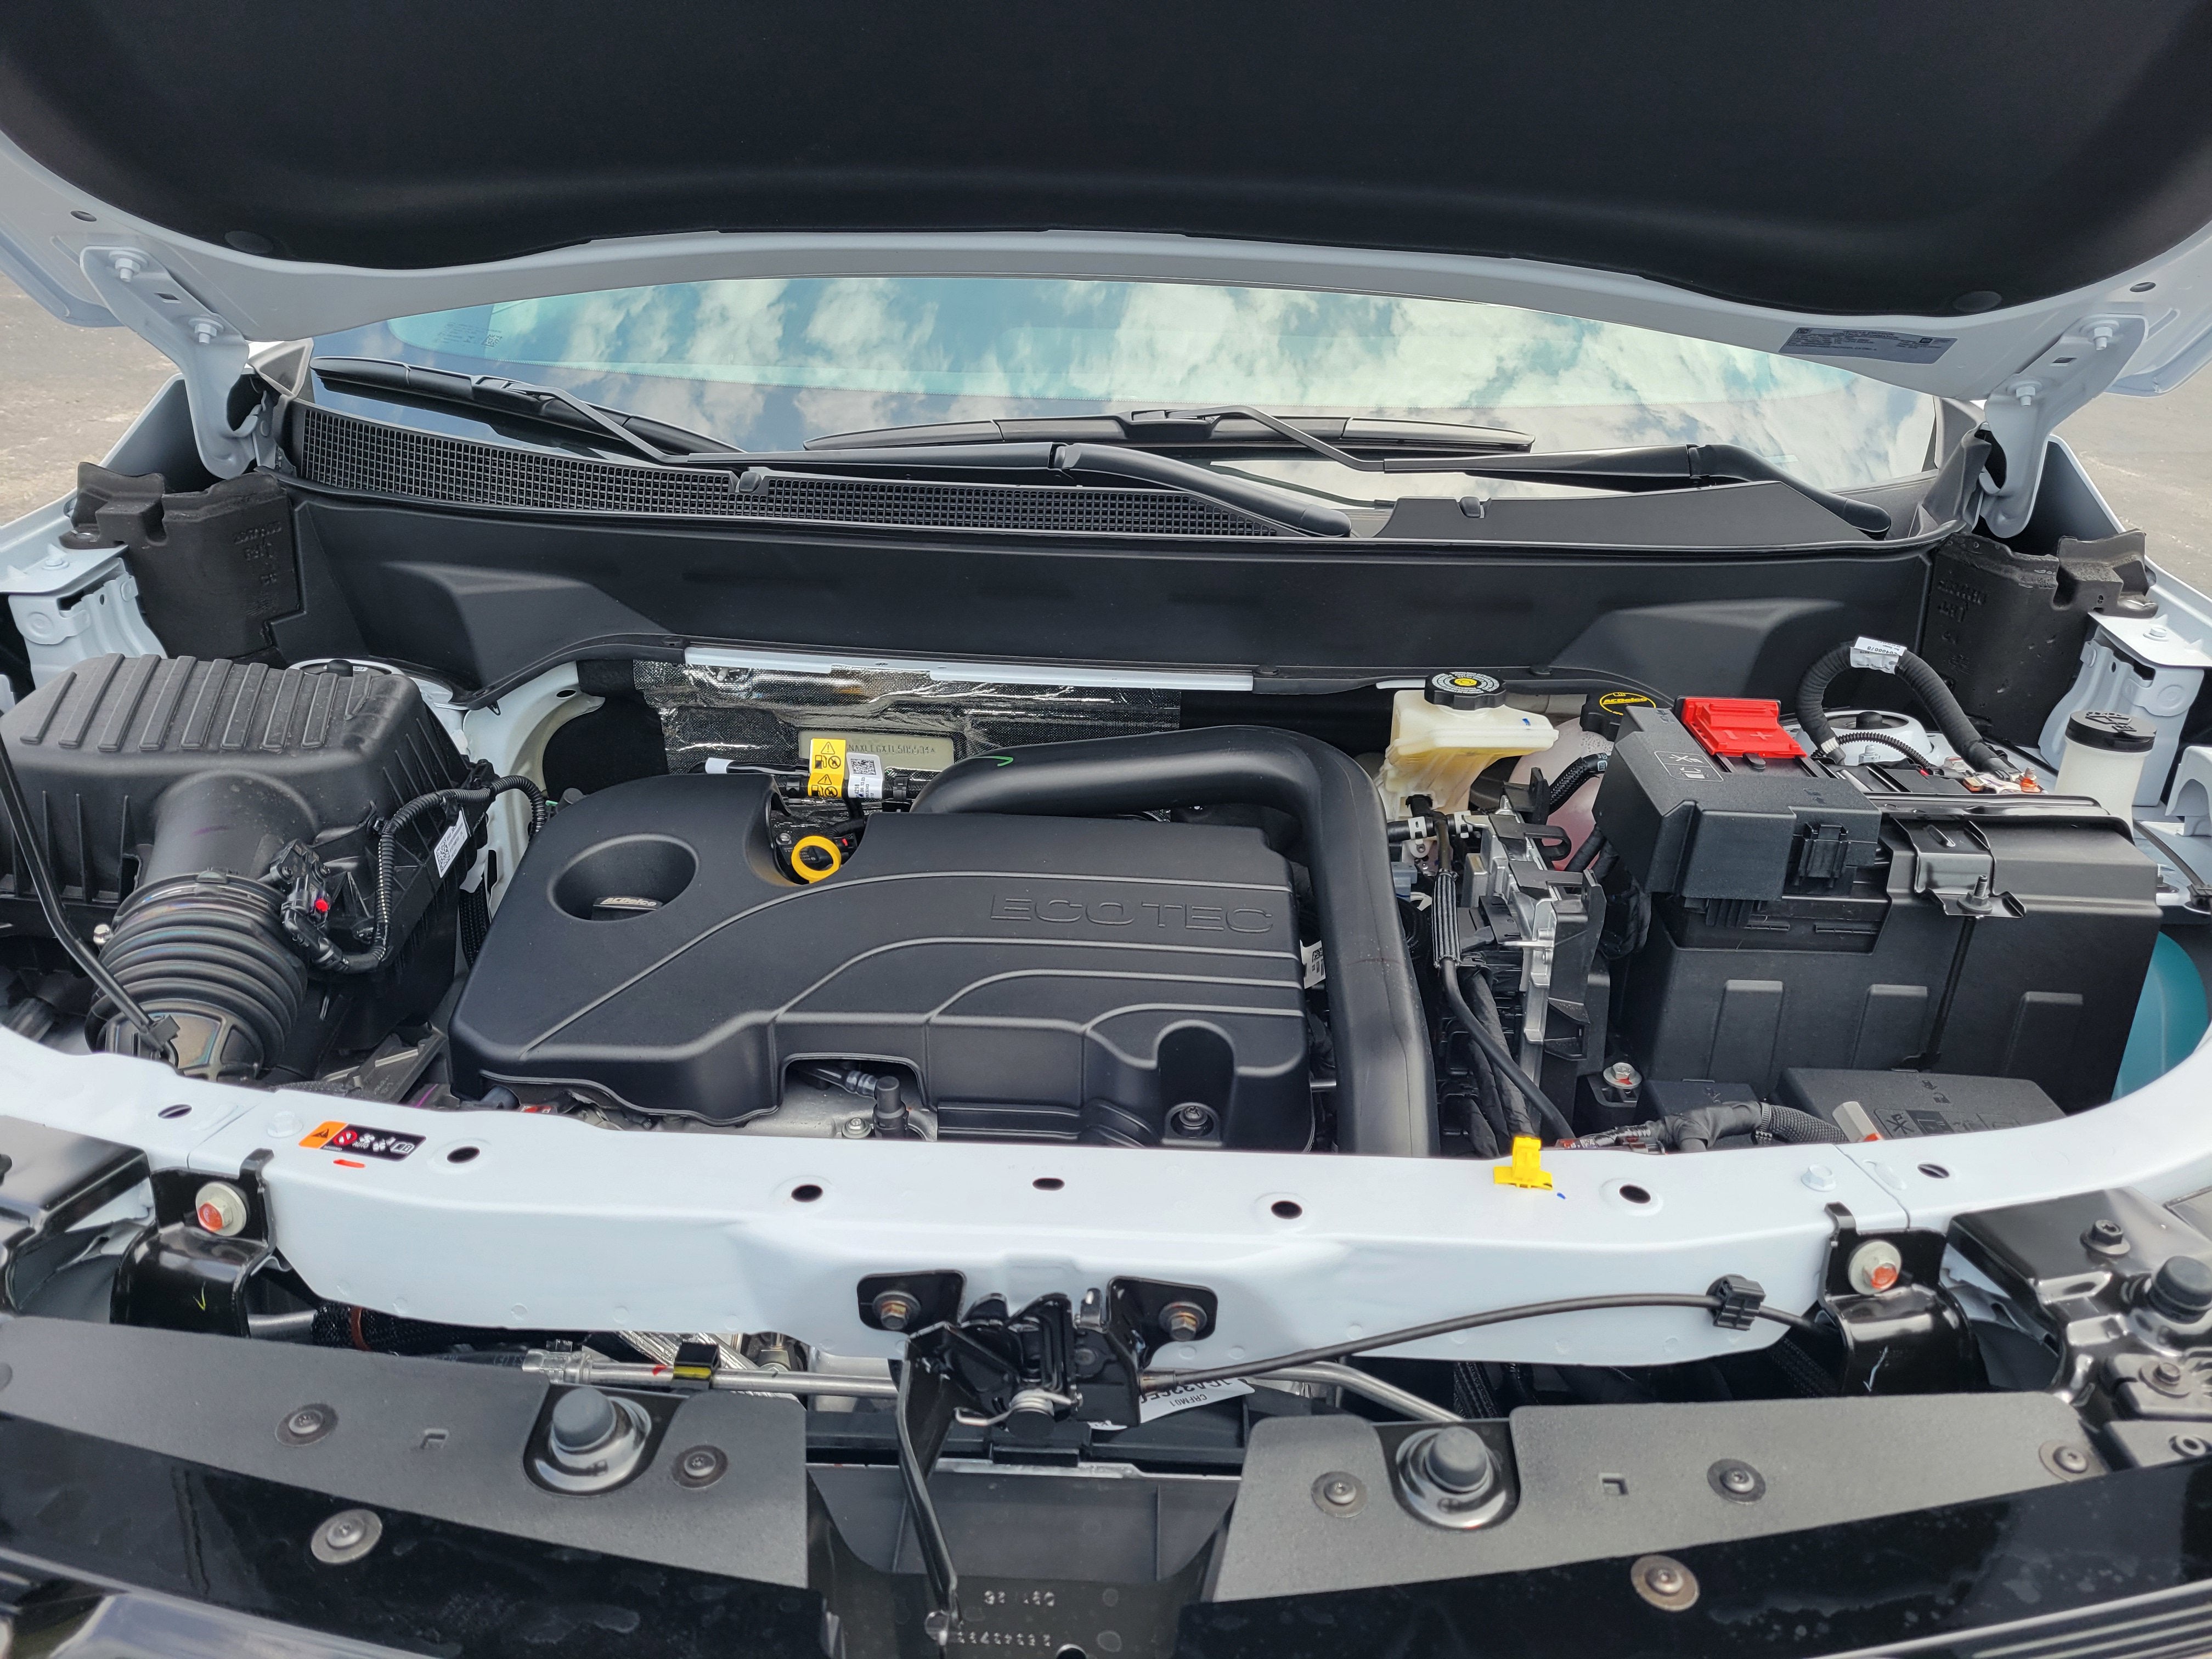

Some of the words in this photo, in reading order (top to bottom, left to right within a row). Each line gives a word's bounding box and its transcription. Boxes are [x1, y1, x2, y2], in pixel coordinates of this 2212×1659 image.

[601, 897, 657, 906] ACDelco
[990, 894, 1273, 933] ECOTEC
[1169, 1393, 1207, 1407] CRFM01
